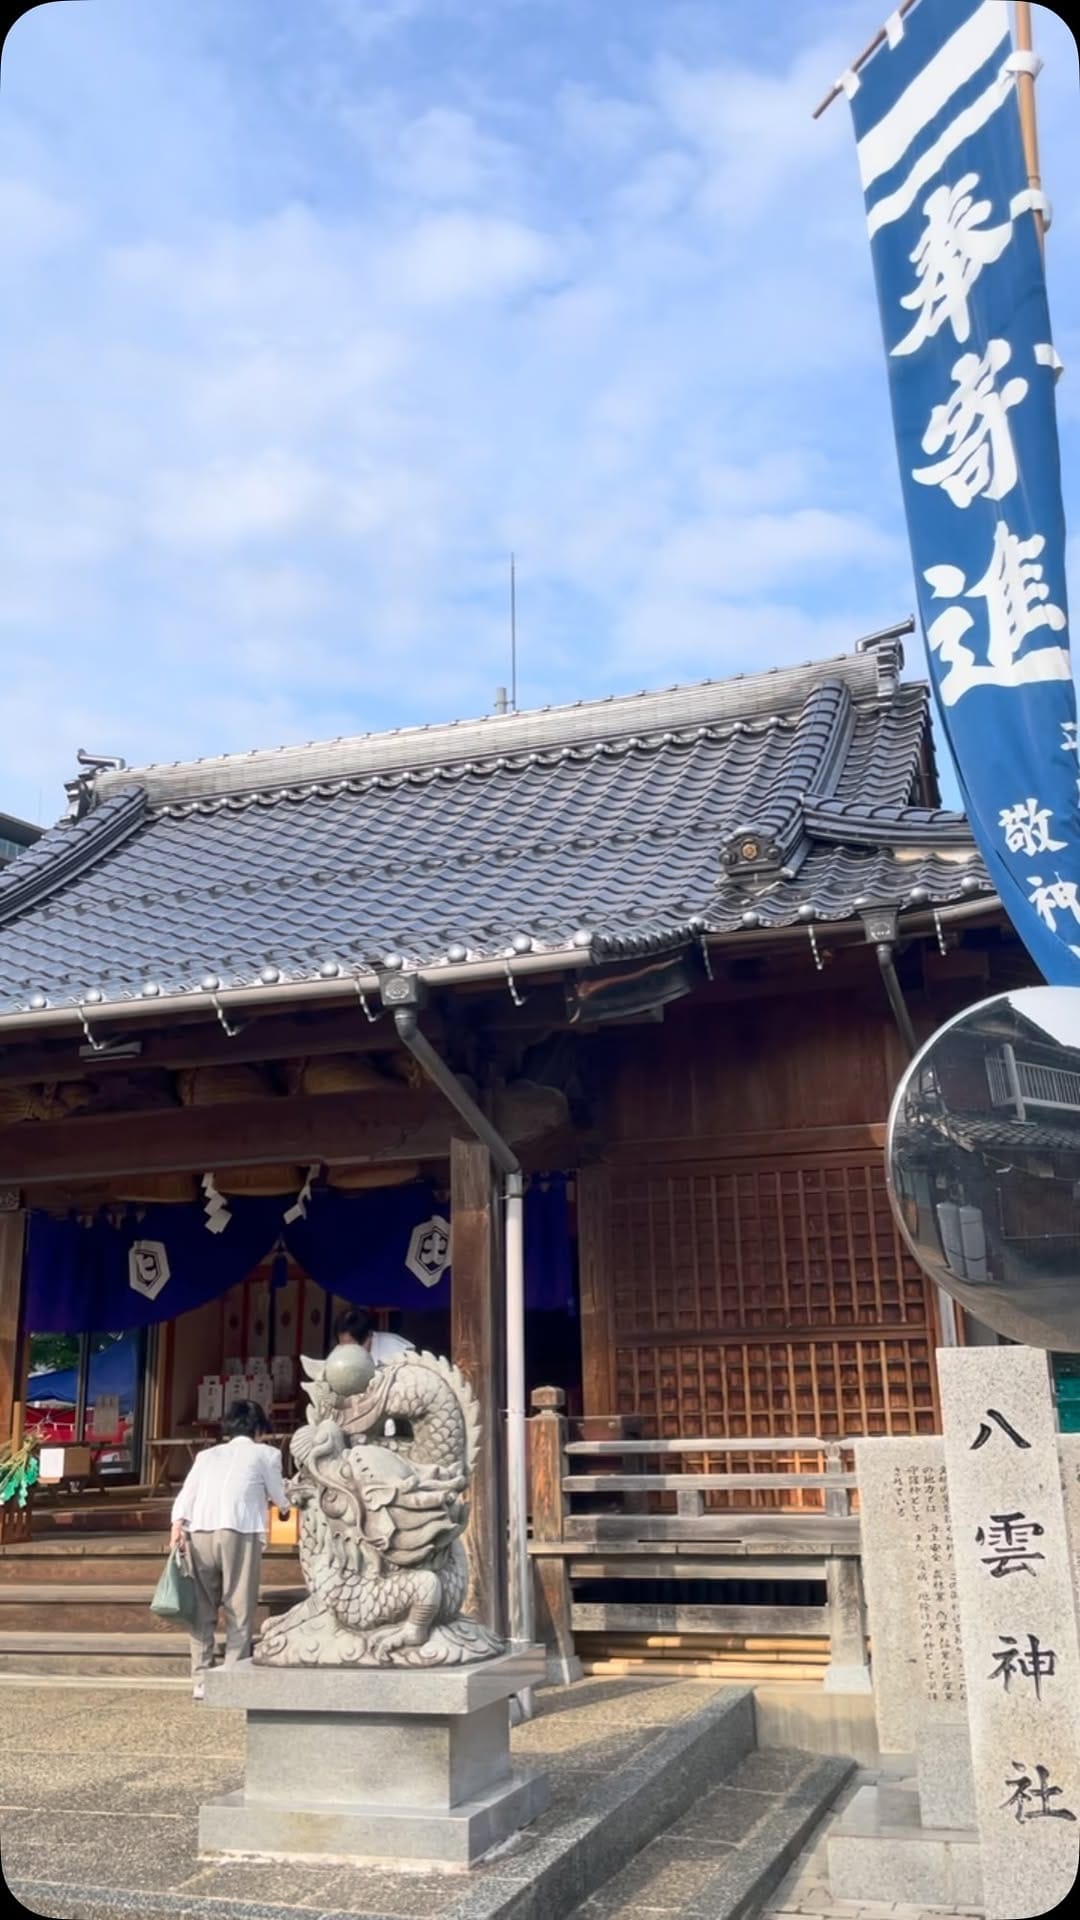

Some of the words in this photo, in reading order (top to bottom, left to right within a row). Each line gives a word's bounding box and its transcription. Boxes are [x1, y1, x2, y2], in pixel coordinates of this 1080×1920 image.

[889, 172, 1072, 707] 奉寄進
[970, 1408, 1077, 1825] 八雲神社
